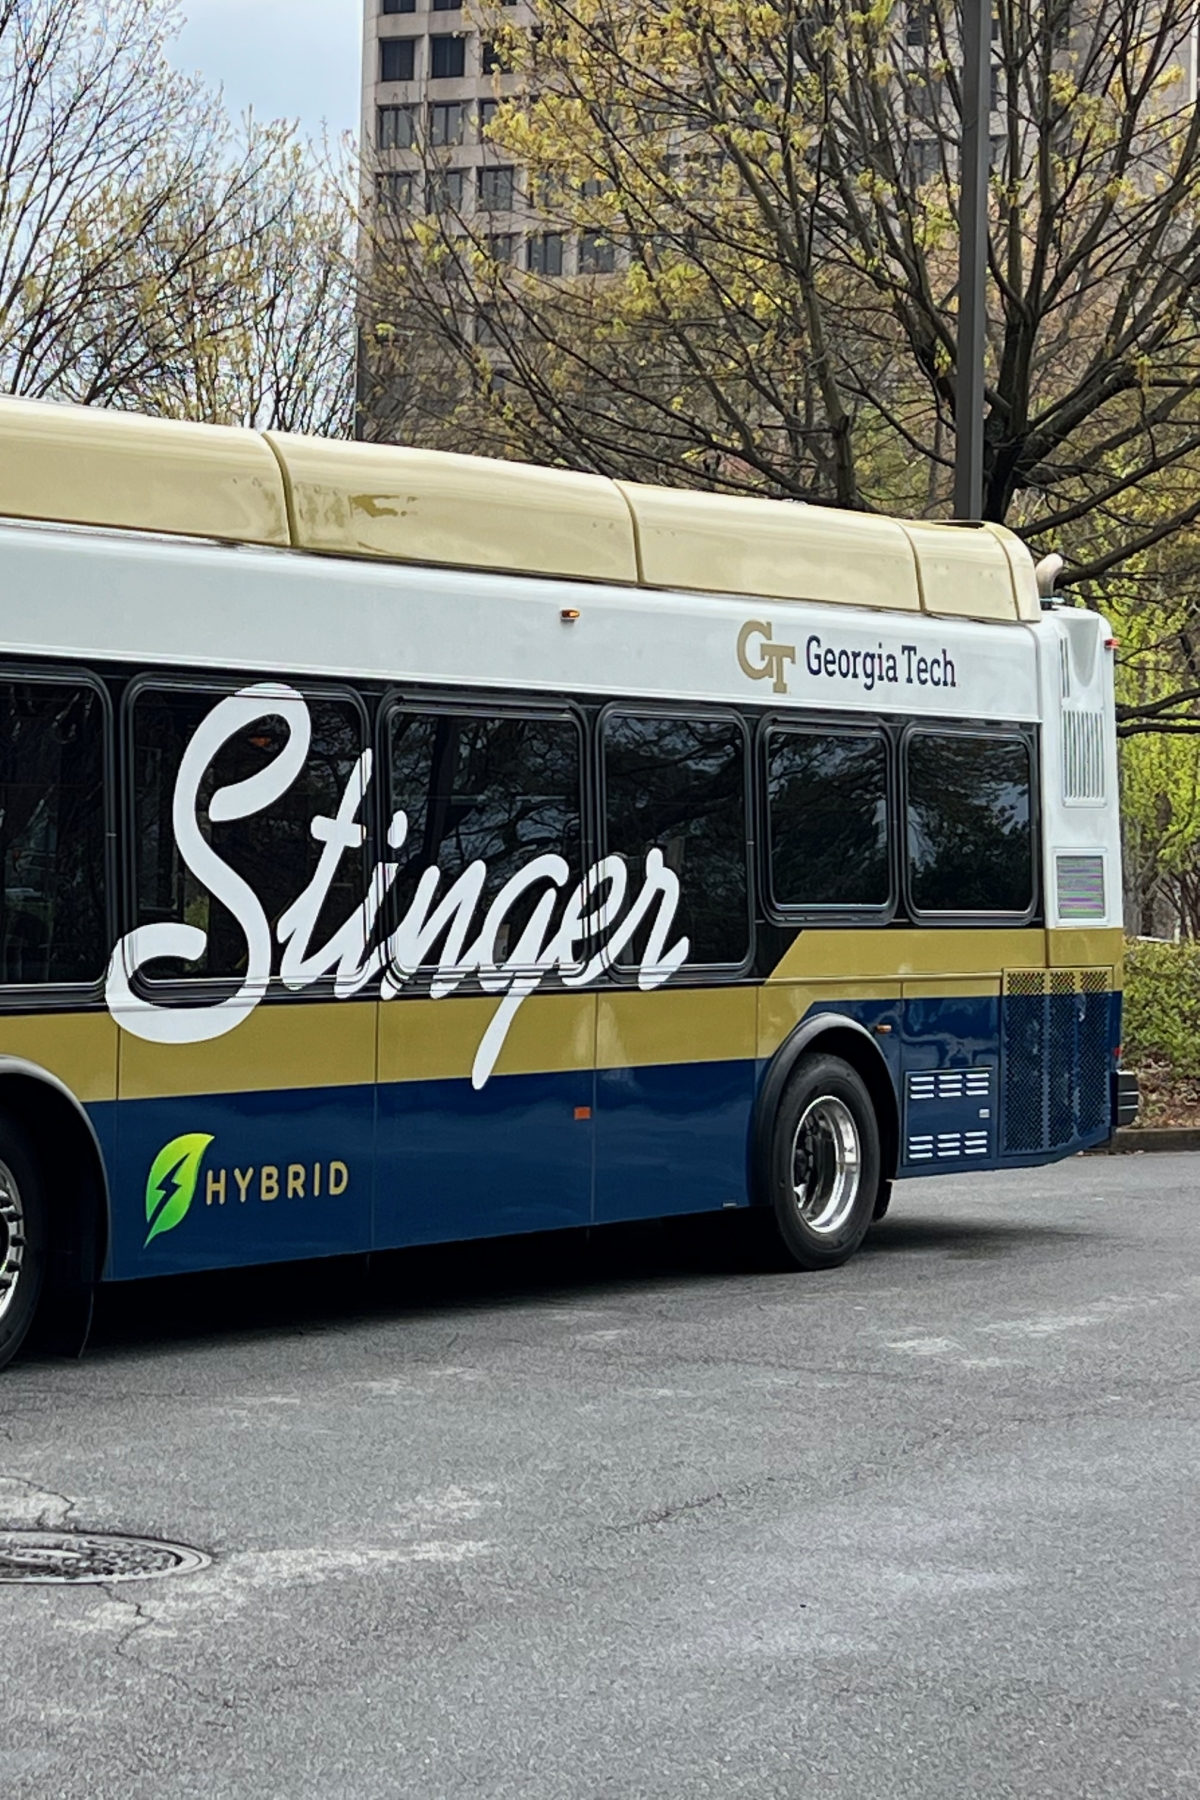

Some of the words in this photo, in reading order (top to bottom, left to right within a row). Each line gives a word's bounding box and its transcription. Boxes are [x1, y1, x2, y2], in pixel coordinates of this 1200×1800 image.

[736, 619, 796, 694] GT
[806, 635, 899, 690] Georgia
[901, 644, 957, 688] Tech
[105, 682, 690, 1090] Stinger
[206, 1160, 349, 1206] HYBRID
